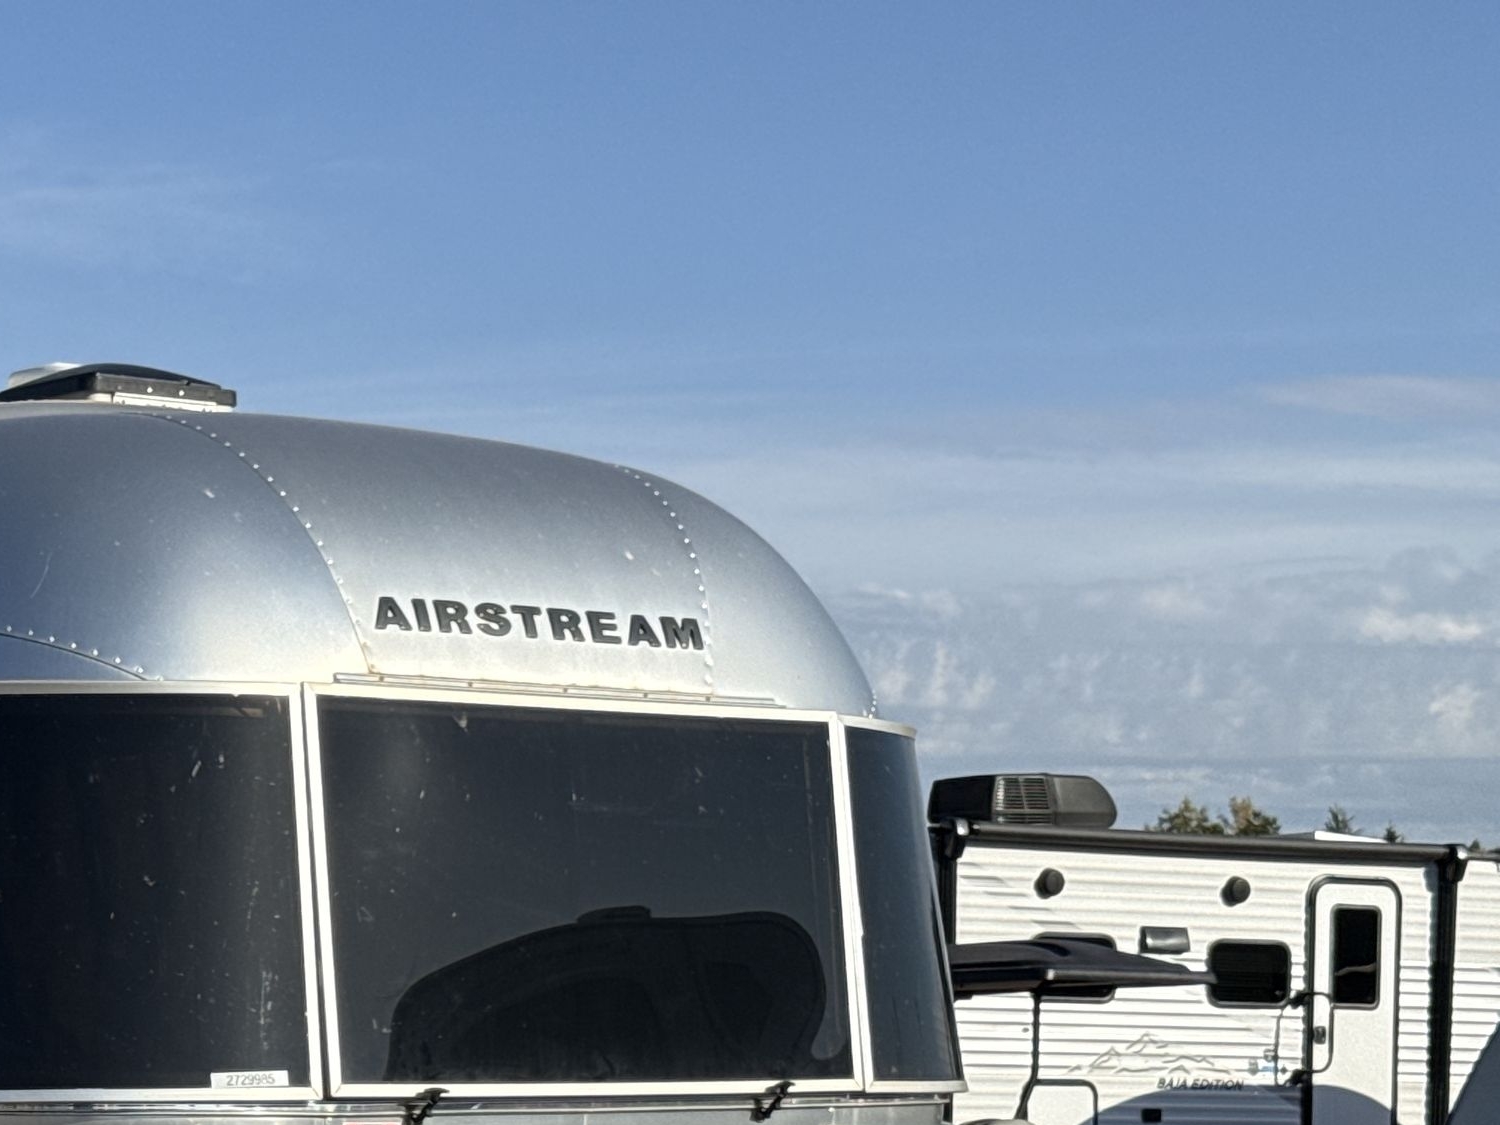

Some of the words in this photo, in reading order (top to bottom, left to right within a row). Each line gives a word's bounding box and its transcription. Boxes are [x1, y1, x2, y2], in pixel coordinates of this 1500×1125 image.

[375, 596, 705, 651] AIRSTREAM
[226, 1073, 276, 1086] 2729985
[1157, 1077, 1188, 1089] BAJA
[1191, 1079, 1244, 1091] EDITION
